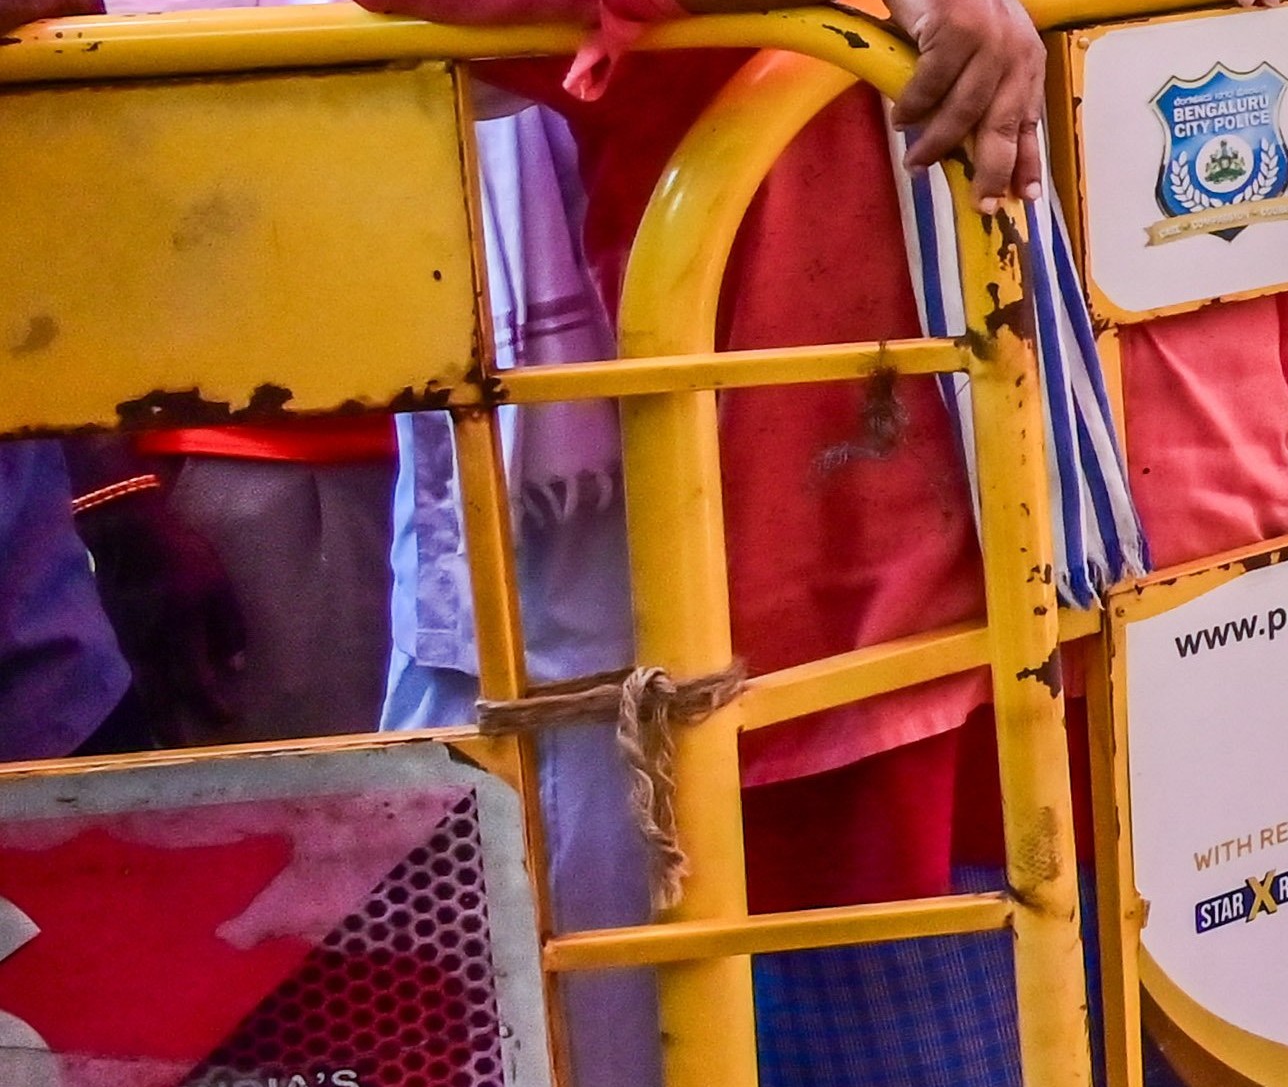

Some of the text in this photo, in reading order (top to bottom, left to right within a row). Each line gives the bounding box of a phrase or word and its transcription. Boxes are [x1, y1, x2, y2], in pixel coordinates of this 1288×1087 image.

[1173, 94, 1270, 123] BENGALURU
[1174, 112, 1270, 138] CITY POLICE
[1193, 834, 1253, 872] WITH
[1200, 892, 1244, 929] STAR
[1245, 869, 1278, 923] X
